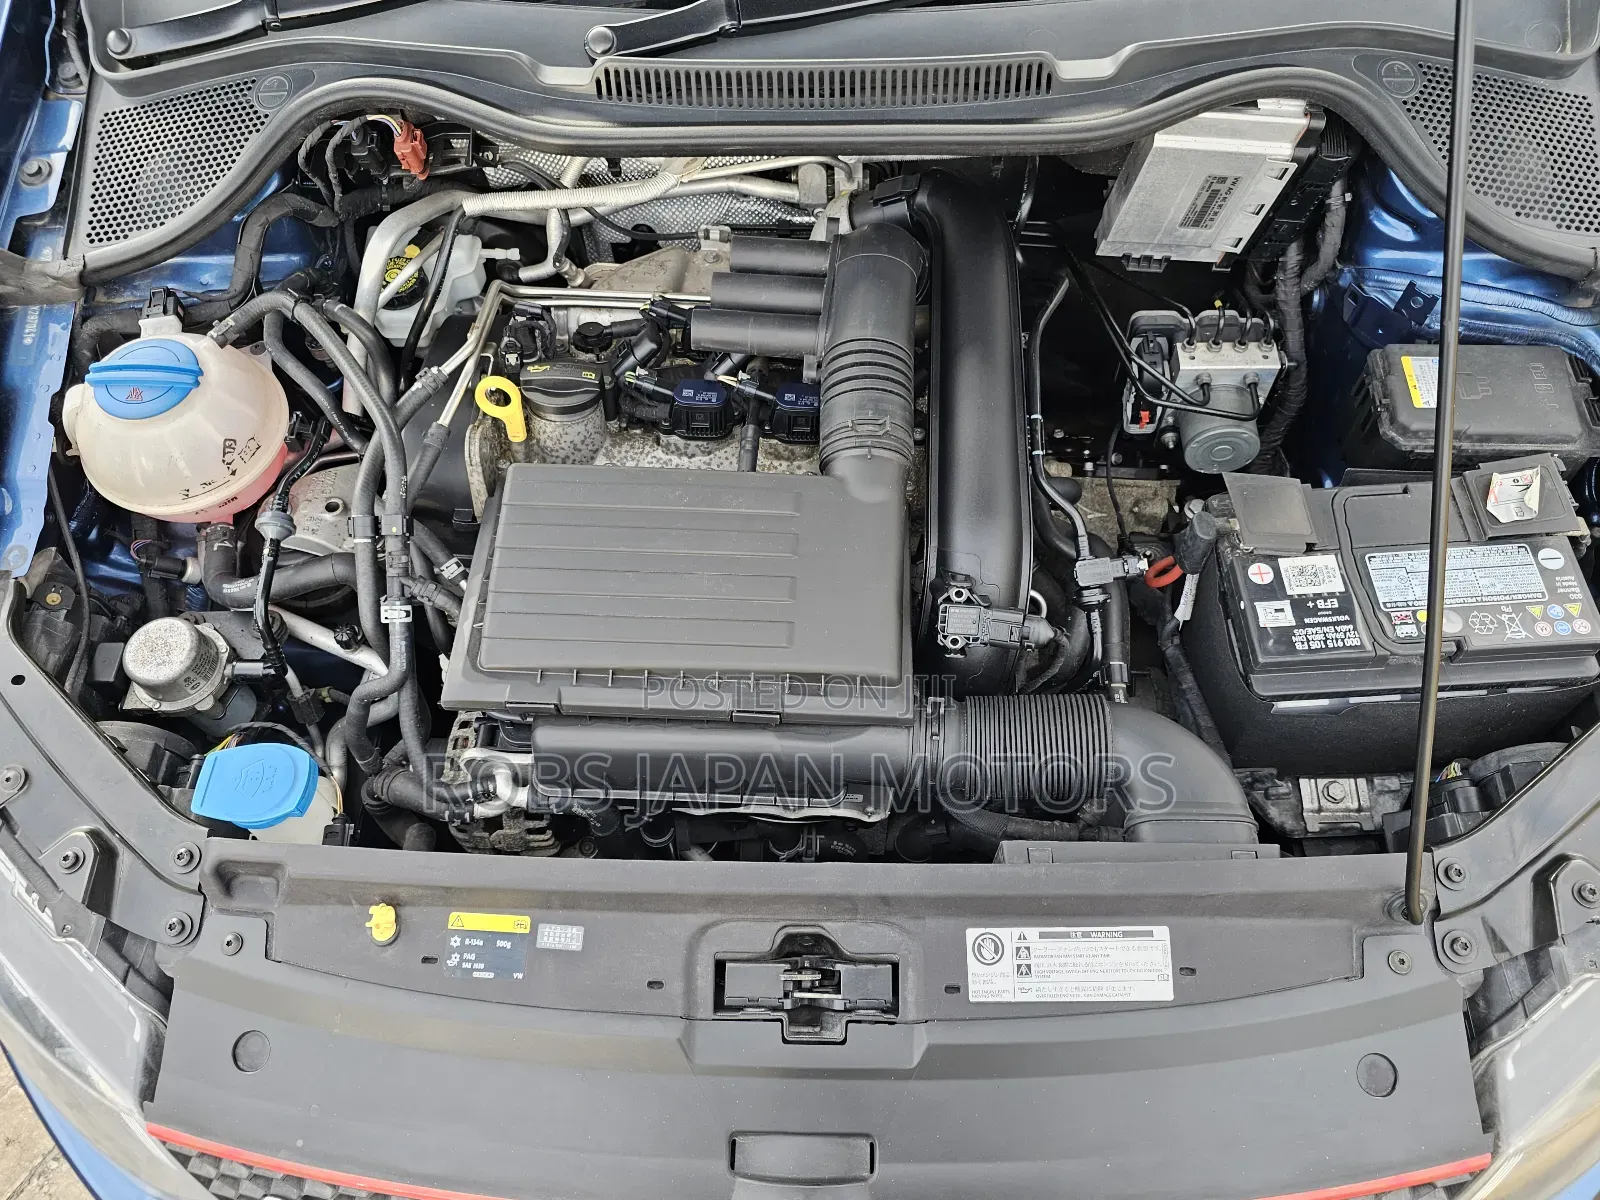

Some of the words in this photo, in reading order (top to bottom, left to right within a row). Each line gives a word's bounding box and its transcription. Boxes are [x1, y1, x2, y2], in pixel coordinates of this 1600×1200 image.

[1316, 598, 1339, 609] EFB
[1500, 604, 1513, 612] Pb
[1304, 614, 1350, 624] VOLKSWAGEN
[1294, 642, 1308, 650] FB
[1308, 640, 1326, 650] 105
[1326, 638, 1344, 648] 915
[1344, 638, 1361, 647] 000
[1090, 930, 1123, 938] WARNING
[496, 940, 512, 949] 500g
[463, 952, 476, 960] PAG
